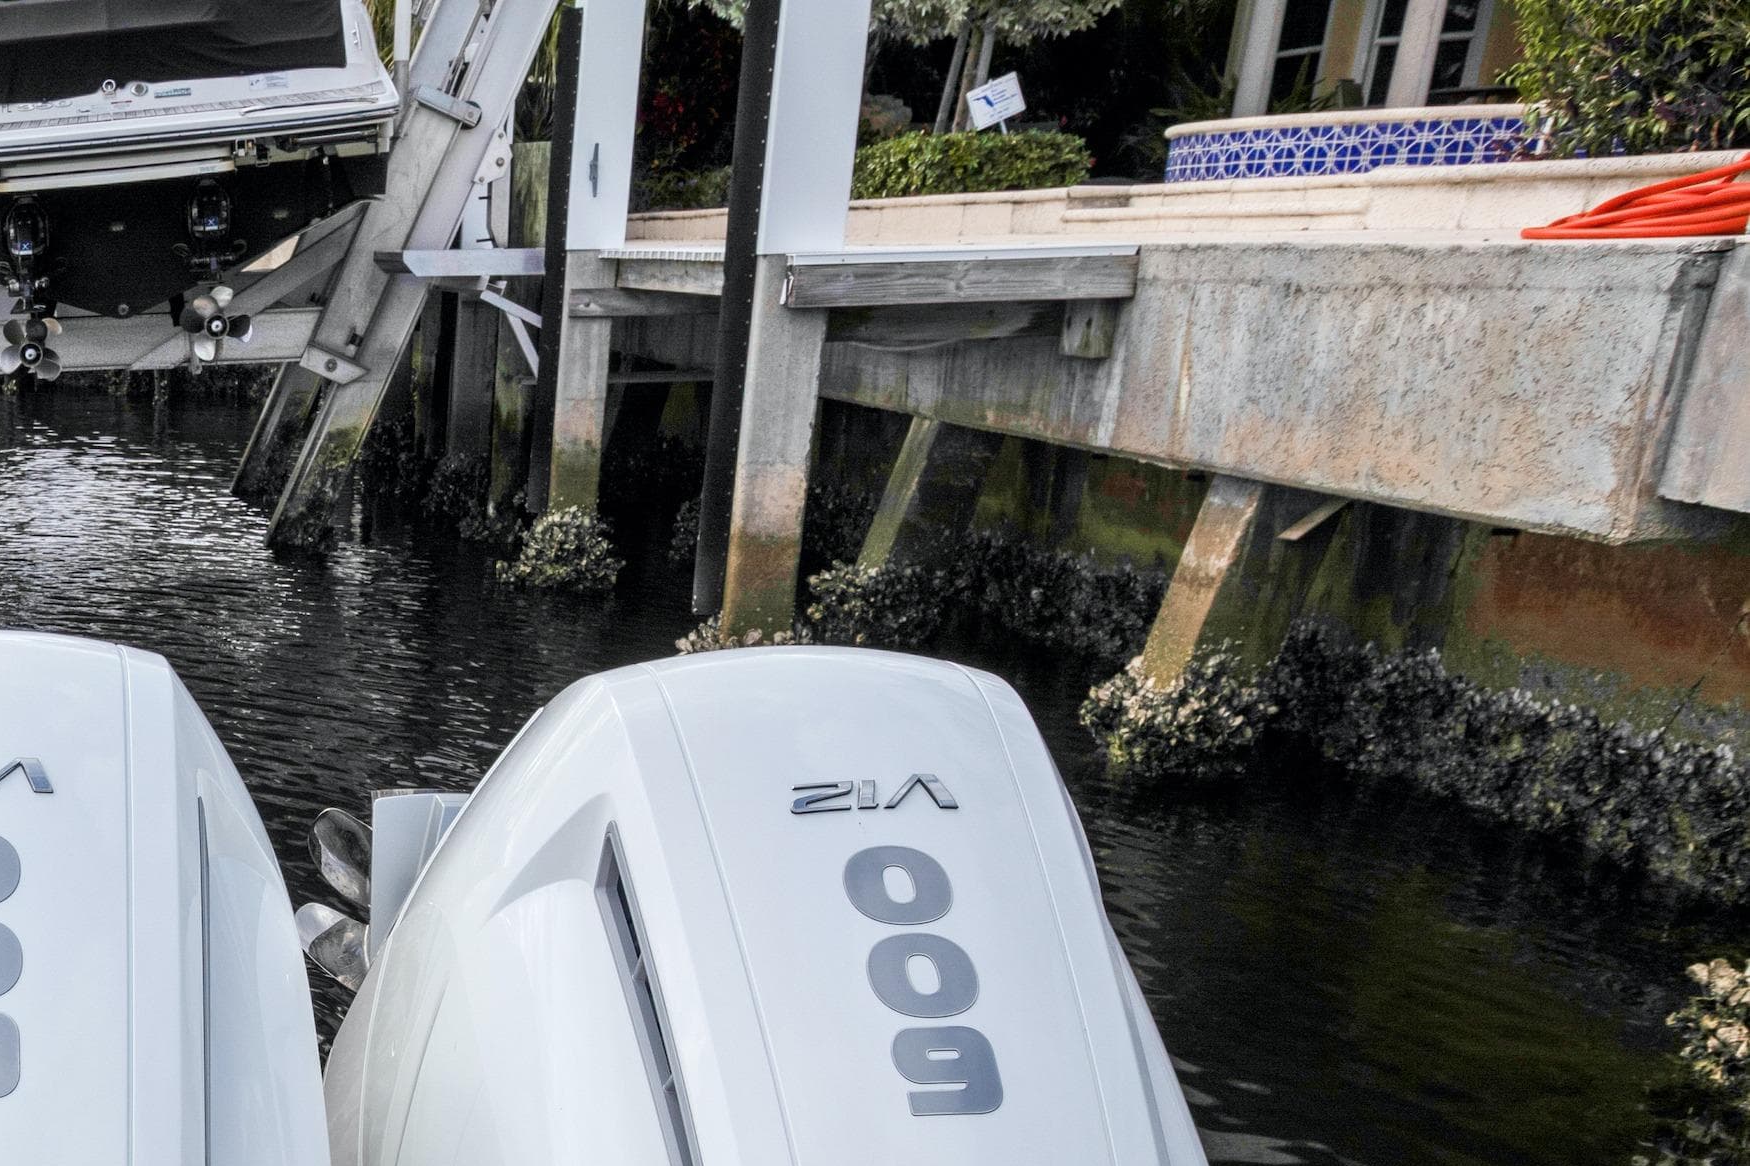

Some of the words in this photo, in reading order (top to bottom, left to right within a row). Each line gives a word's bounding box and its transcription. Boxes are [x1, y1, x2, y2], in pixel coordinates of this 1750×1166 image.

[1, 103, 12, 113] FL
[790, 773, 958, 814] V12
[842, 845, 1003, 1117] 600
